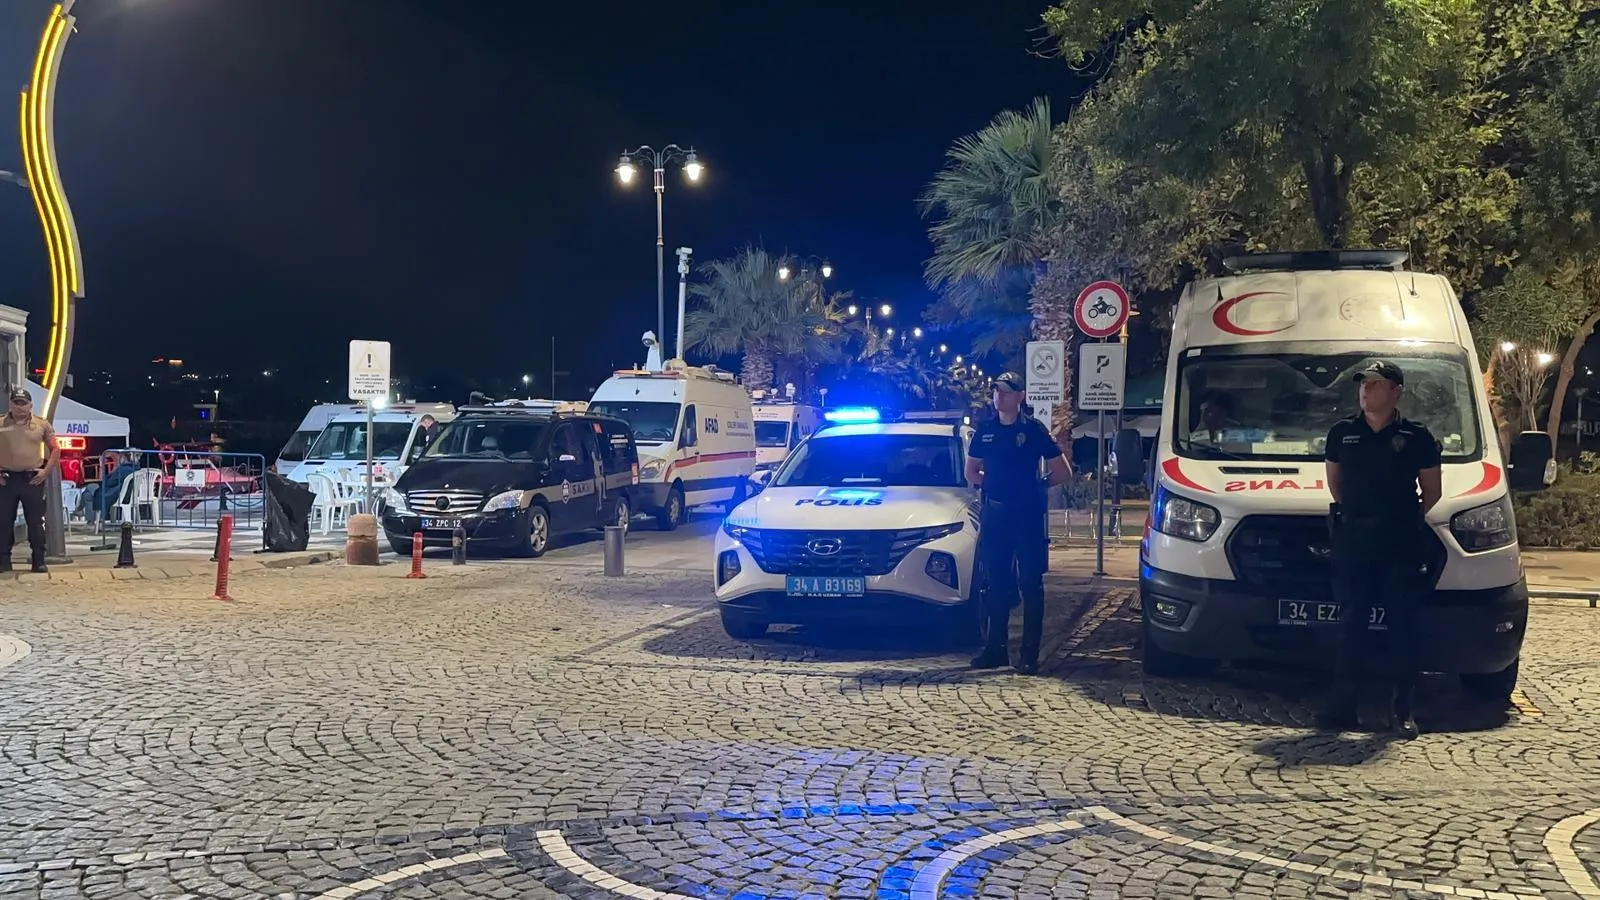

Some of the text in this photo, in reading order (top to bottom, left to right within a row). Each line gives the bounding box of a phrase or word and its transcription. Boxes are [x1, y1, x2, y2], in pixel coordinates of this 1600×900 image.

[66, 423, 90, 434] AFAD
[704, 417, 719, 434] AFAD
[423, 519, 461, 528] 34 ZPC 12
[794, 578, 861, 592] 34 A 83169
[1289, 602, 1308, 620] 34
[1317, 604, 1341, 621] EZ
